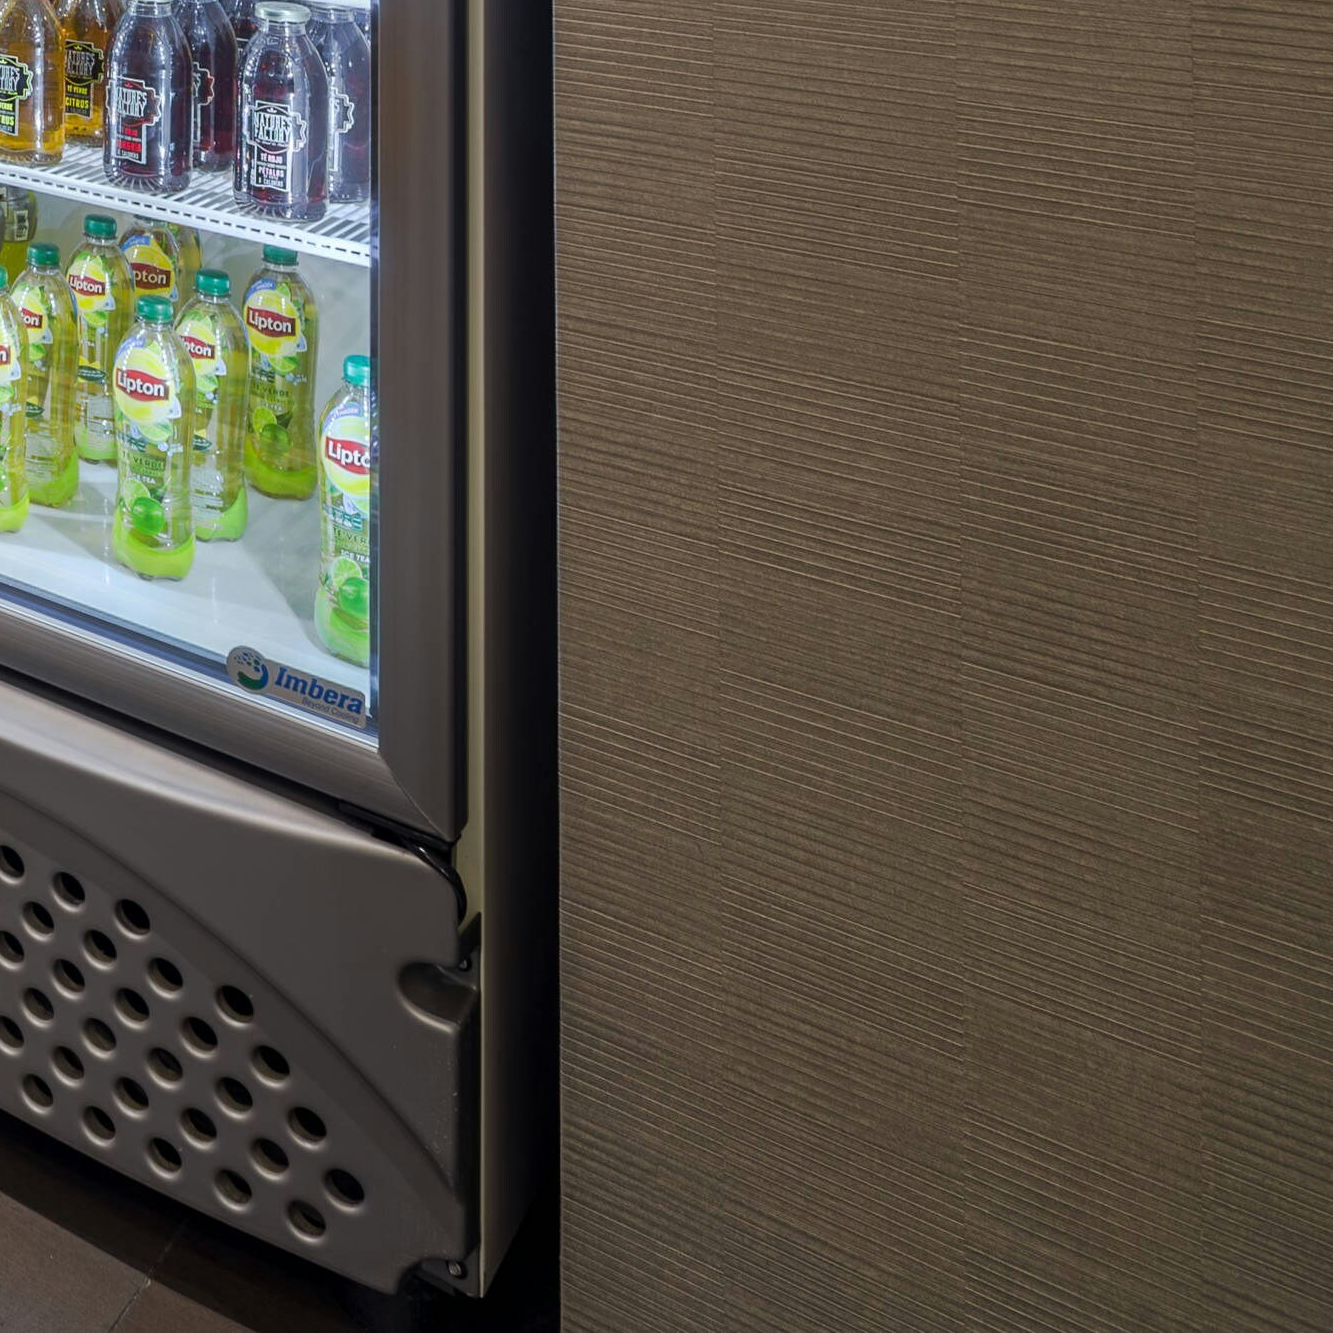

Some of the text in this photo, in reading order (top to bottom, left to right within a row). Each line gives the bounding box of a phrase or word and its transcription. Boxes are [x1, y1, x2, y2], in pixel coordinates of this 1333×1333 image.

[69, 276, 103, 295] Lipton
[133, 270, 167, 287] pton
[248, 309, 293, 334] Lipton
[116, 371, 166, 398] Lipton
[327, 442, 371, 468] Lipto
[274, 666, 363, 715] Imbera
